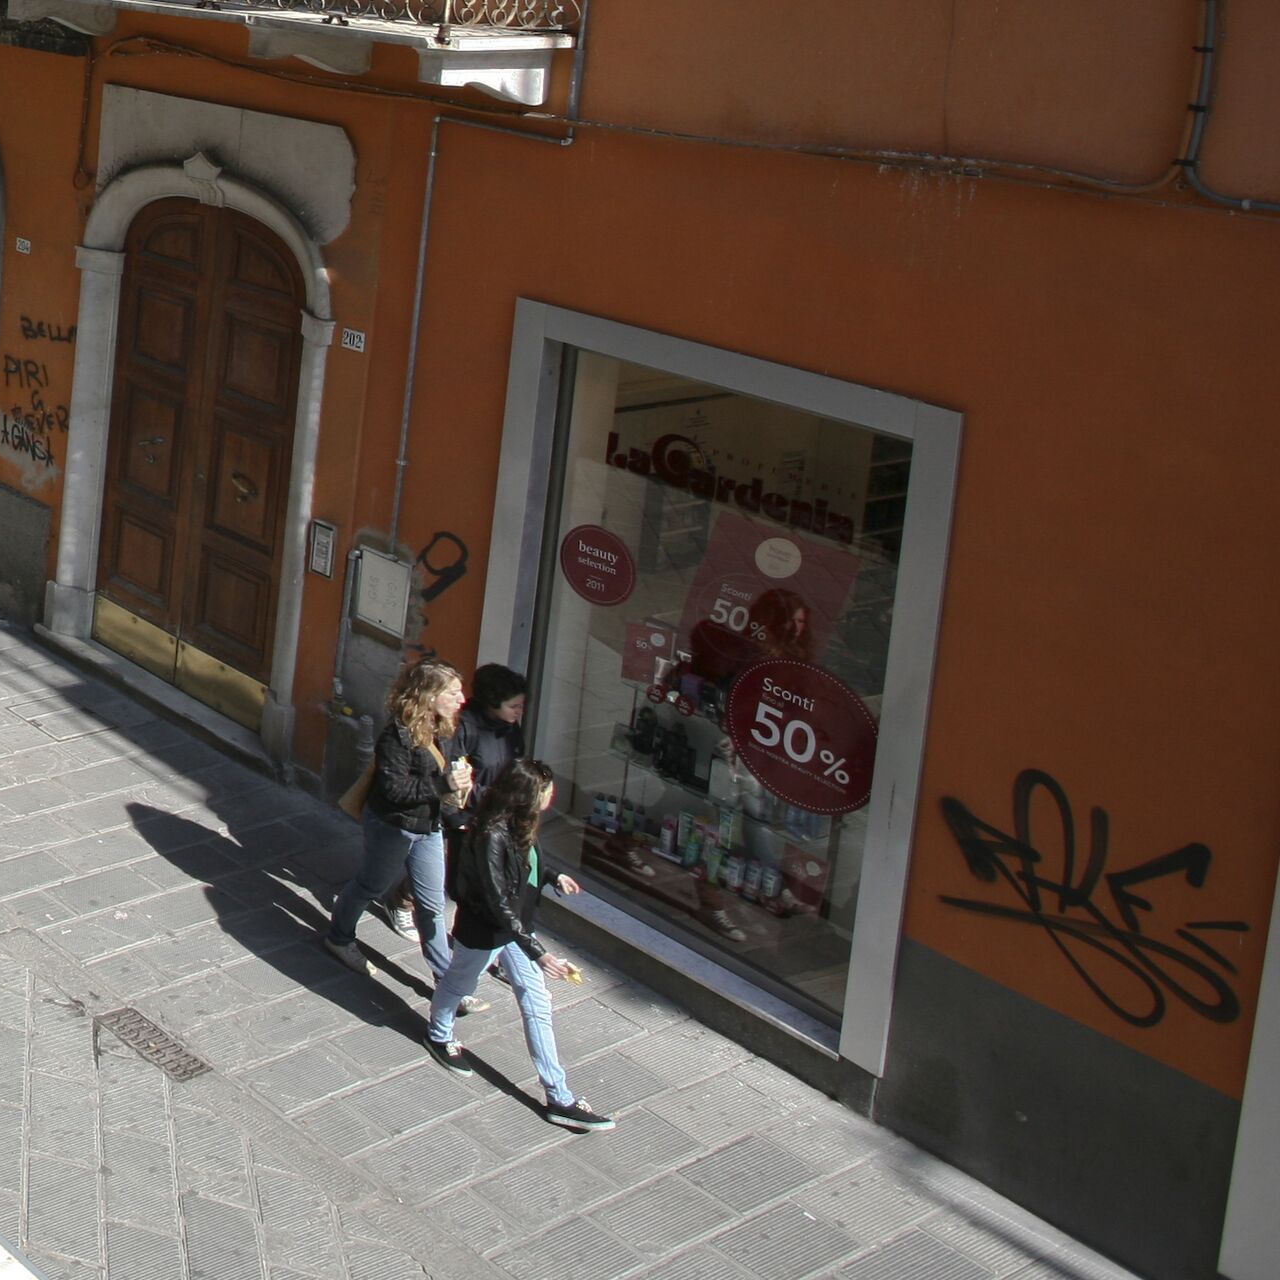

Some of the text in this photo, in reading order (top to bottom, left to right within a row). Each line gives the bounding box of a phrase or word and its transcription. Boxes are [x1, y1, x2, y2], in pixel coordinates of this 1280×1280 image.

[343, 330, 362, 349] 202
[578, 539, 618, 566] beauty
[577, 557, 617, 576] selection
[585, 578, 605, 592] 2011
[721, 583, 753, 601] Sconti
[710, 598, 767, 640] 50%
[762, 677, 815, 712] Sconti
[750, 701, 850, 784] 50%
